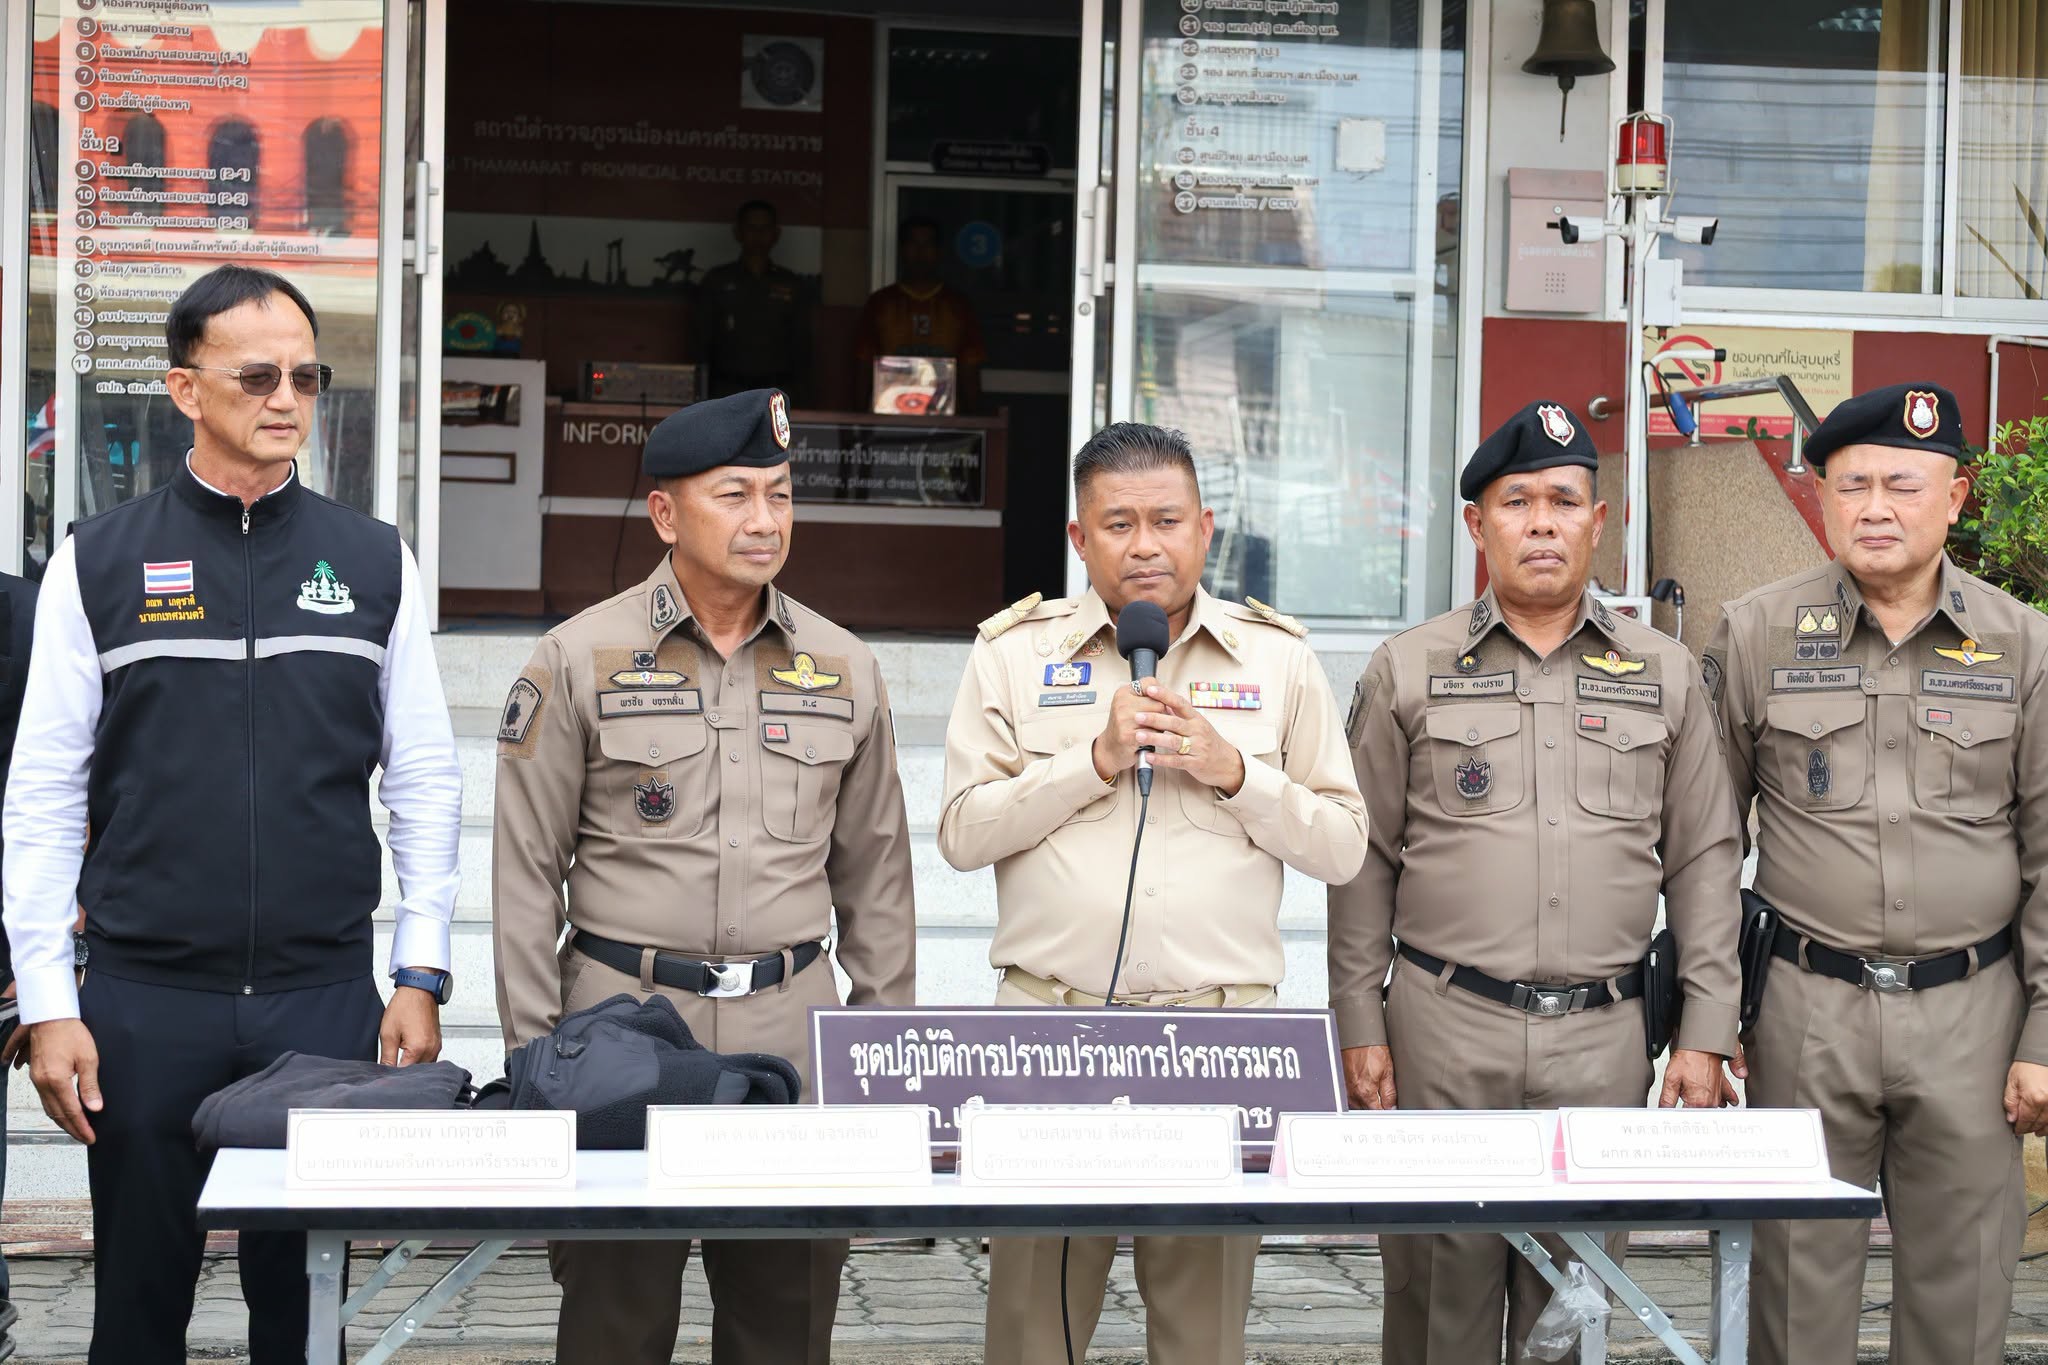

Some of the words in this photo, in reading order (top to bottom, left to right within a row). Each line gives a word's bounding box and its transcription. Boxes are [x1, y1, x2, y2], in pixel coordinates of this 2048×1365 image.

[219, 50, 248, 63] (1-1)
[218, 76, 247, 88] (1-2)
[80, 129, 102, 150] ชั้น
[107, 137, 119, 151] 2
[1210, 126, 1219, 136] 4
[463, 156, 571, 177] THAMMARAT
[581, 161, 681, 182] PROVINCIAL
[687, 166, 745, 183] POLICE
[751, 168, 824, 187] STATION
[218, 192, 248, 206] (2-2)
[1732, 347, 1841, 369] ขอบคุณที่ไม่สูบบุหรี่
[807, 474, 844, 489] Office,
[847, 477, 885, 493] please
[886, 477, 916, 490] dress
[139, 605, 205, 623] นายกเทศมนตรี
[849, 1023, 1302, 1096] ชุดปฏิบัติการปราบปรามการโจรกรรมรถ
